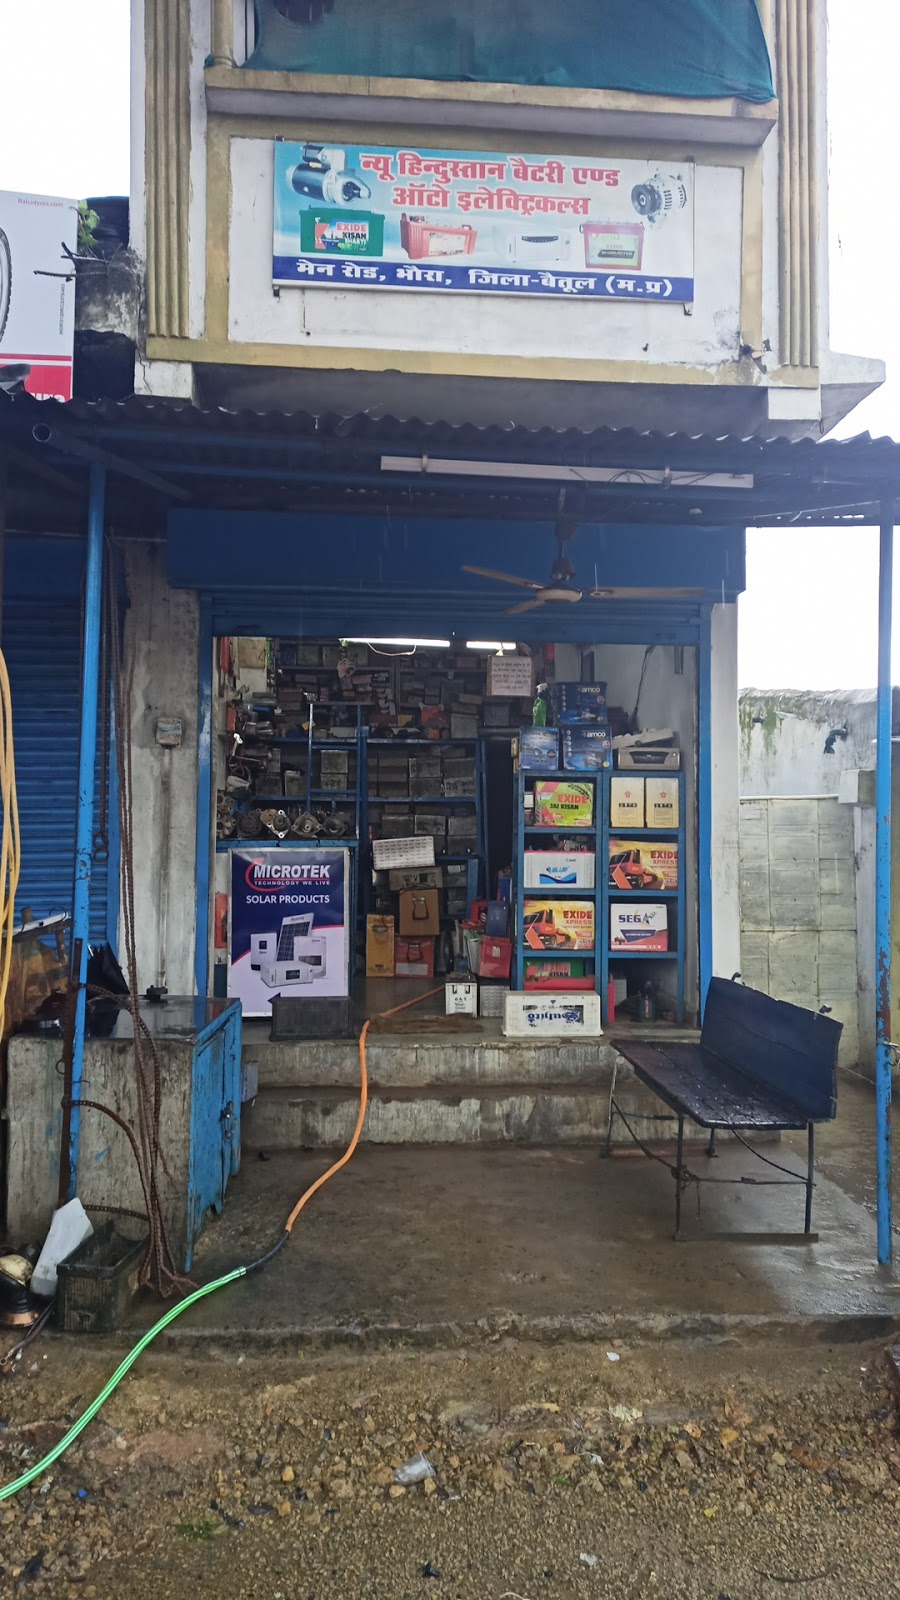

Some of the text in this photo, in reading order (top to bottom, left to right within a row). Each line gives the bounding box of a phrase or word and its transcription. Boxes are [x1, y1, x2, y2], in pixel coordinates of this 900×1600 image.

[360, 152, 620, 187] न्यू हिन्दुस्तान बैटरी एण्ड
[392, 183, 450, 208] ऑटो
[336, 223, 366, 232] EXIDE
[296, 259, 335, 276] मेन
[341, 261, 386, 282] रोड,
[396, 265, 452, 286] भौरा,
[468, 268, 597, 293] जिला-बैतूल
[557, 794, 588, 804] EXIDE
[650, 850, 679, 859] EXIDE
[253, 865, 331, 879] MICROTEK
[246, 894, 330, 904] SOLAR PRODUCTS
[563, 910, 593, 919] EXIDE
